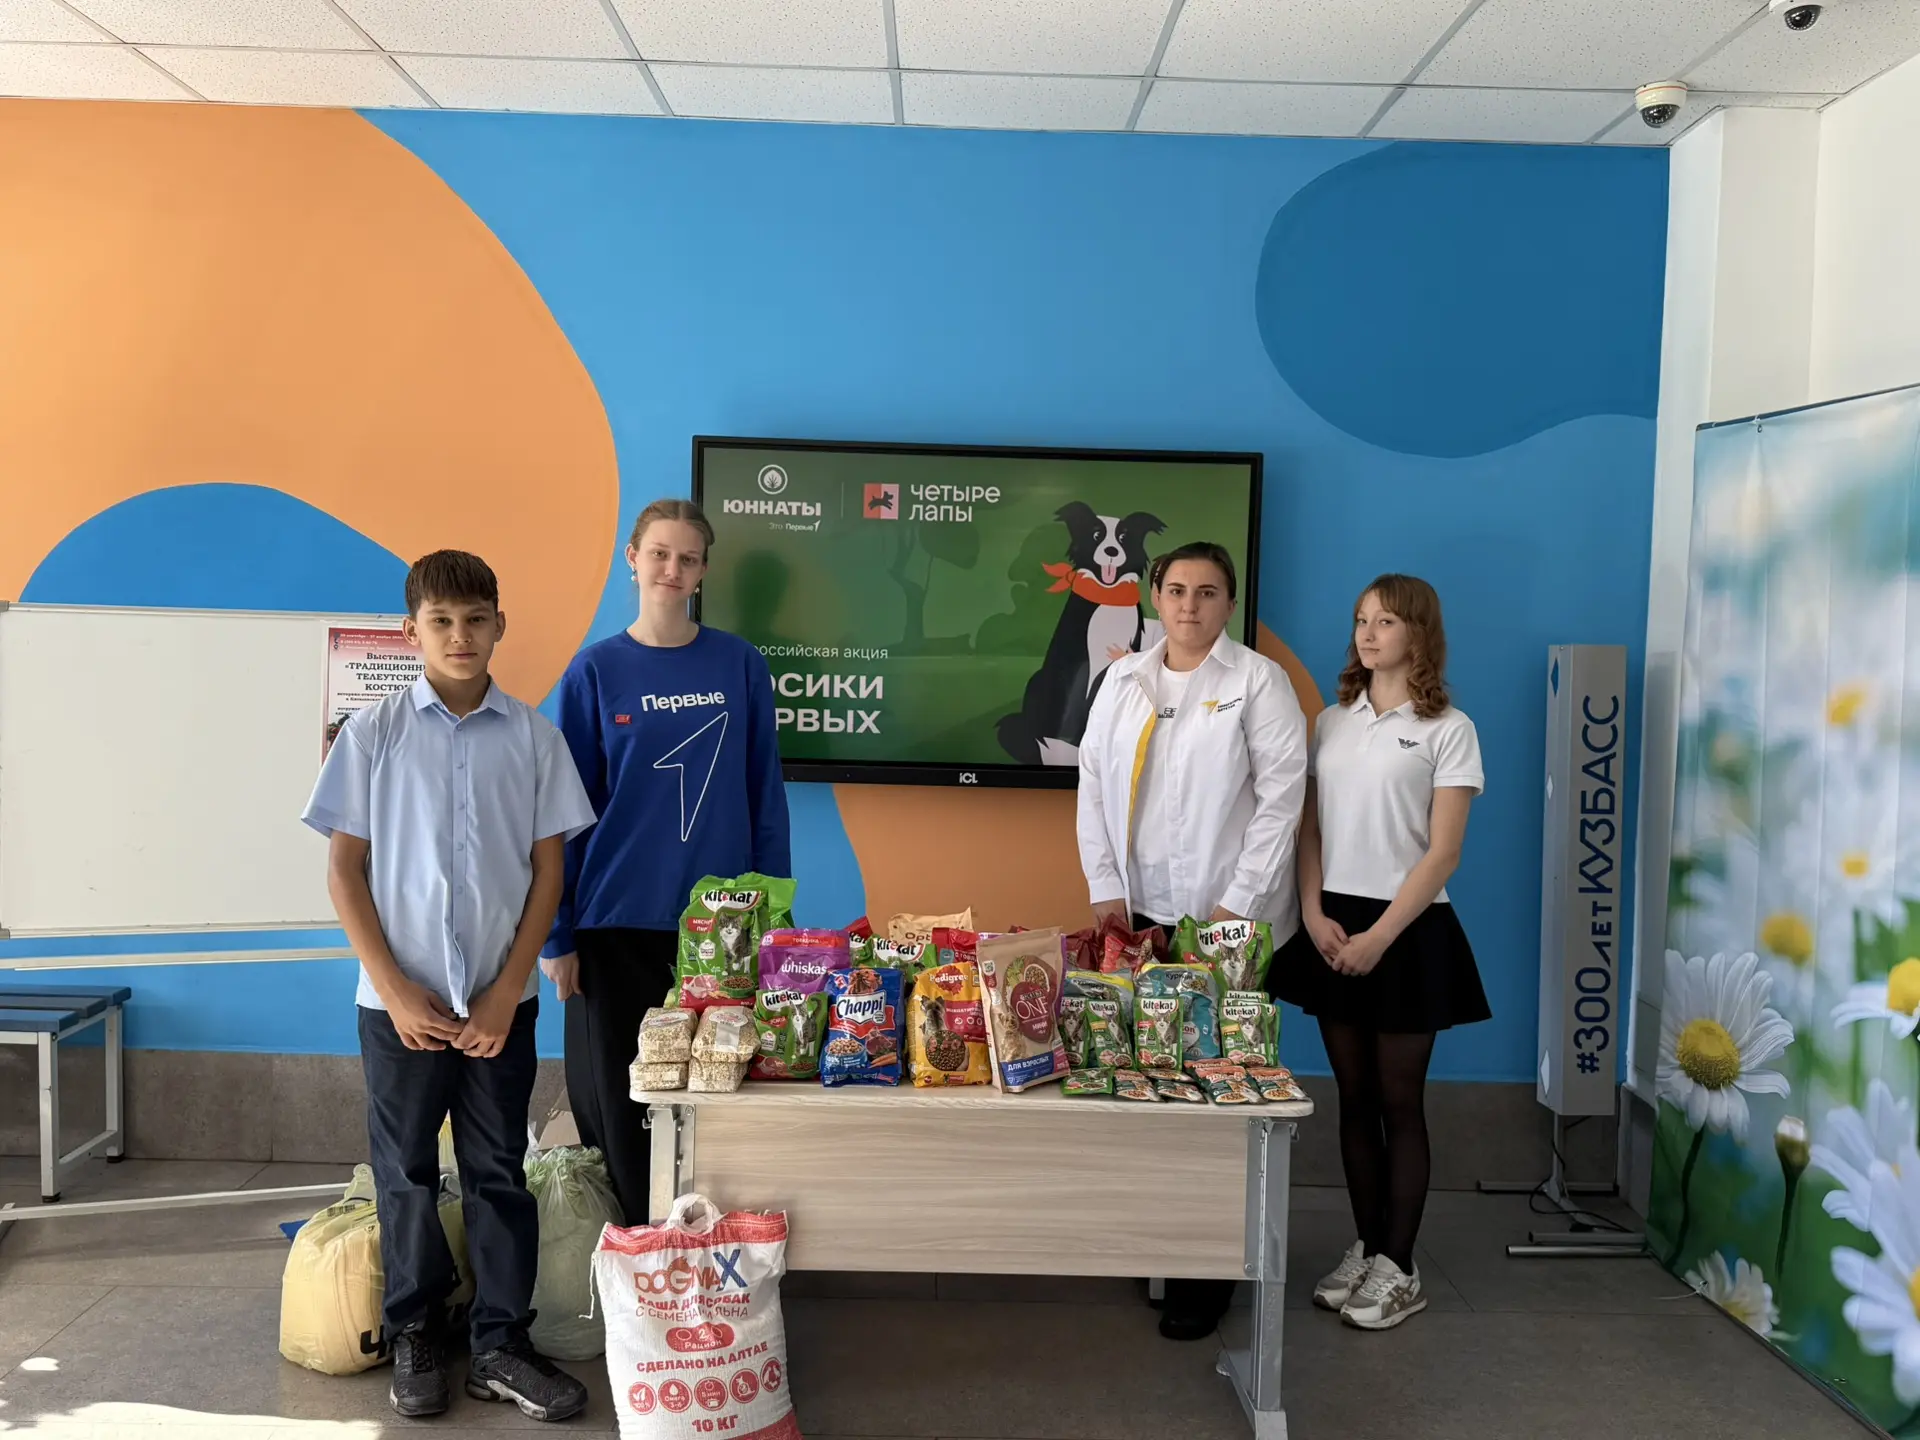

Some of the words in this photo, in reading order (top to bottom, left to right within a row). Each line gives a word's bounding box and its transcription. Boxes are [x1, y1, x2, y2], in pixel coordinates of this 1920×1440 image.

[723, 499, 822, 516] ЮННАТЫ
[366, 652, 416, 661] Выставка
[755, 644, 839, 657] оссийская
[843, 647, 888, 661] акция
[641, 691, 726, 714] Первые
[905, 932, 932, 942] Opt
[781, 960, 828, 975] whiskas
[836, 996, 883, 1019] Chappi
[1062, 999, 1084, 1009] tekat
[1143, 1001, 1174, 1010] kitekat
[1226, 1008, 1256, 1016] kitekat
[636, 1359, 705, 1373] СДЕЛАНО
[706, 1356, 726, 1368] НА
[728, 1341, 768, 1364] АЛТАЕ
[691, 1418, 714, 1432] 10
[717, 1414, 738, 1431] КГ
